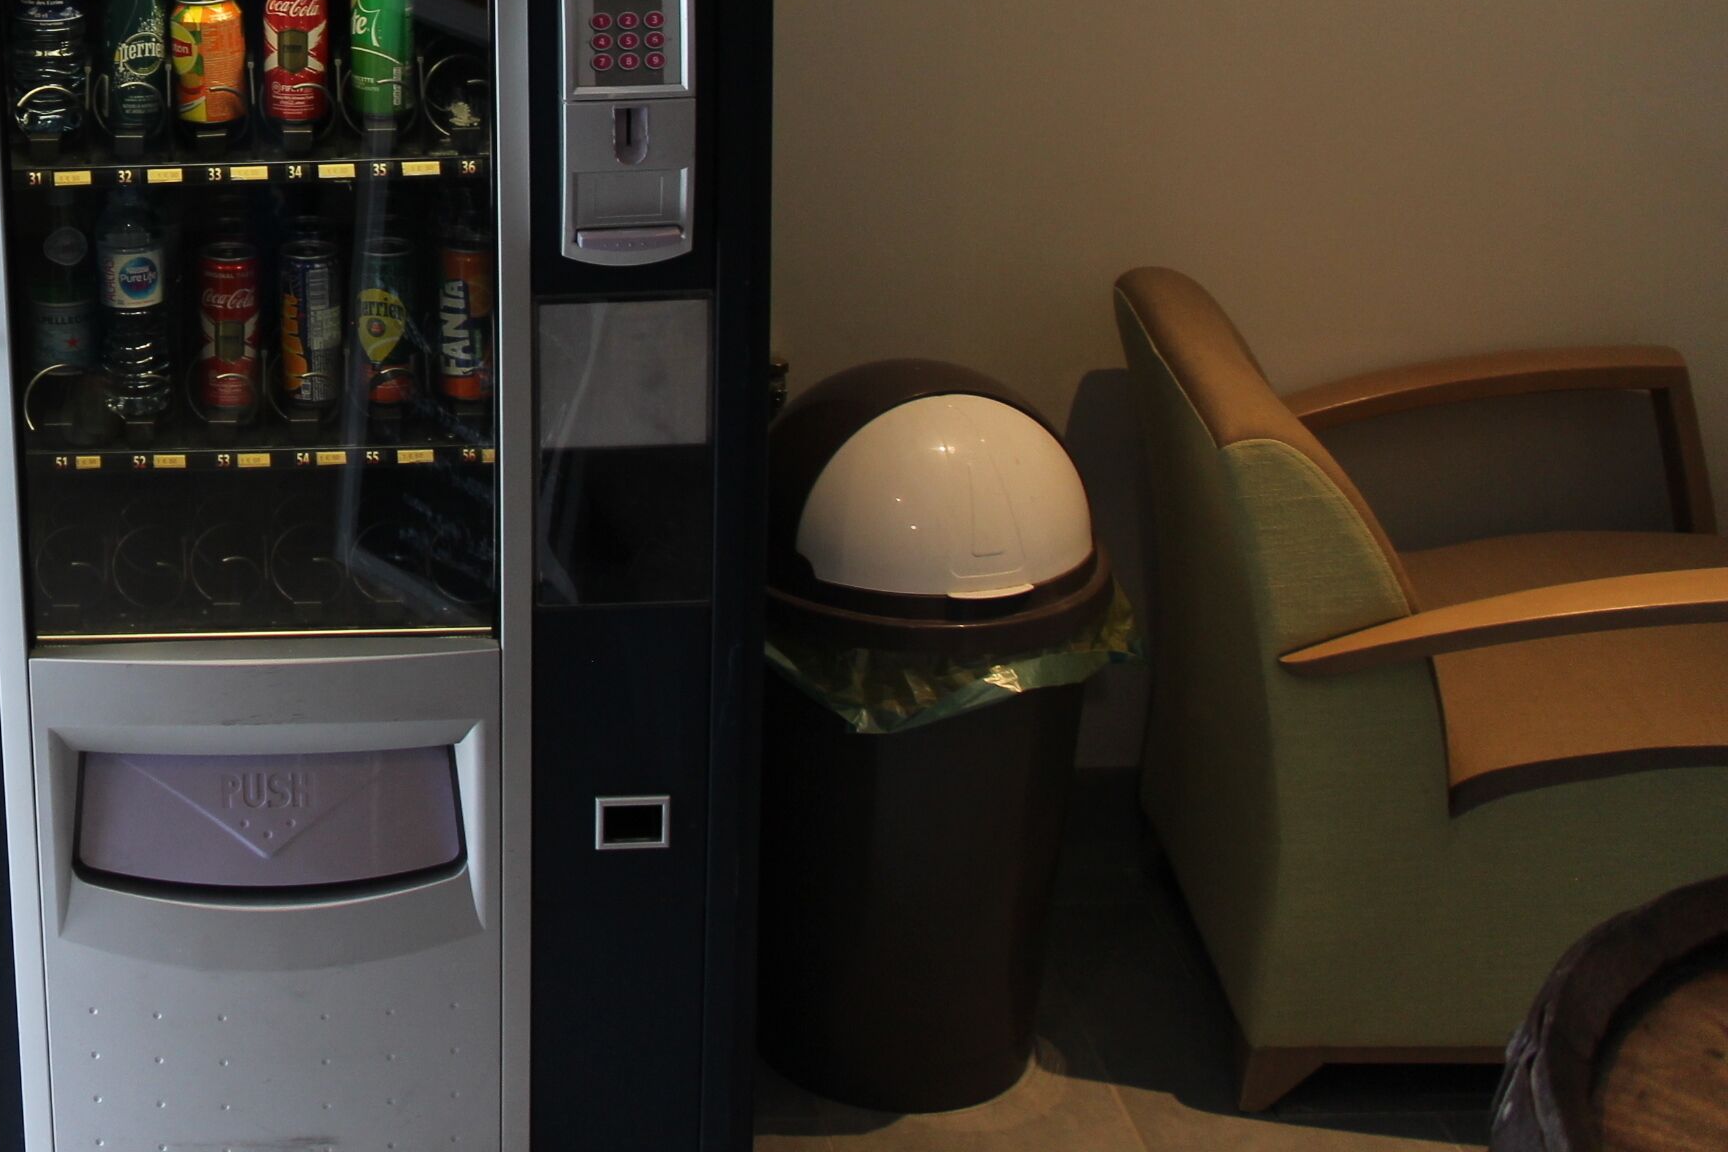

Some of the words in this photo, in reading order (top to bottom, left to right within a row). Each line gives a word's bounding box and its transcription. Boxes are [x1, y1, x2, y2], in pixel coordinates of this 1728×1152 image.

[598, 17, 604, 26] 1
[625, 16, 632, 25] 2
[652, 15, 658, 24] 3
[599, 37, 605, 46] 4
[625, 36, 632, 45] 5
[652, 35, 659, 44] 6
[599, 57, 606, 67] 7
[625, 56, 632, 66] 8
[652, 55, 659, 65] 9
[288, 166, 302, 179] 34
[373, 163, 387, 176] 35
[462, 161, 476, 174] 36
[29, 172, 42, 185] 31
[118, 170, 132, 183] 32
[208, 168, 222, 181] 33
[200, 286, 257, 310] Coca-Cola
[133, 455, 147, 468] 52
[217, 454, 231, 467] 53
[296, 452, 310, 465] 54
[366, 450, 379, 463] 55
[463, 449, 476, 462] 56
[55, 456, 68, 469] 51
[220, 772, 313, 809] PUSH
